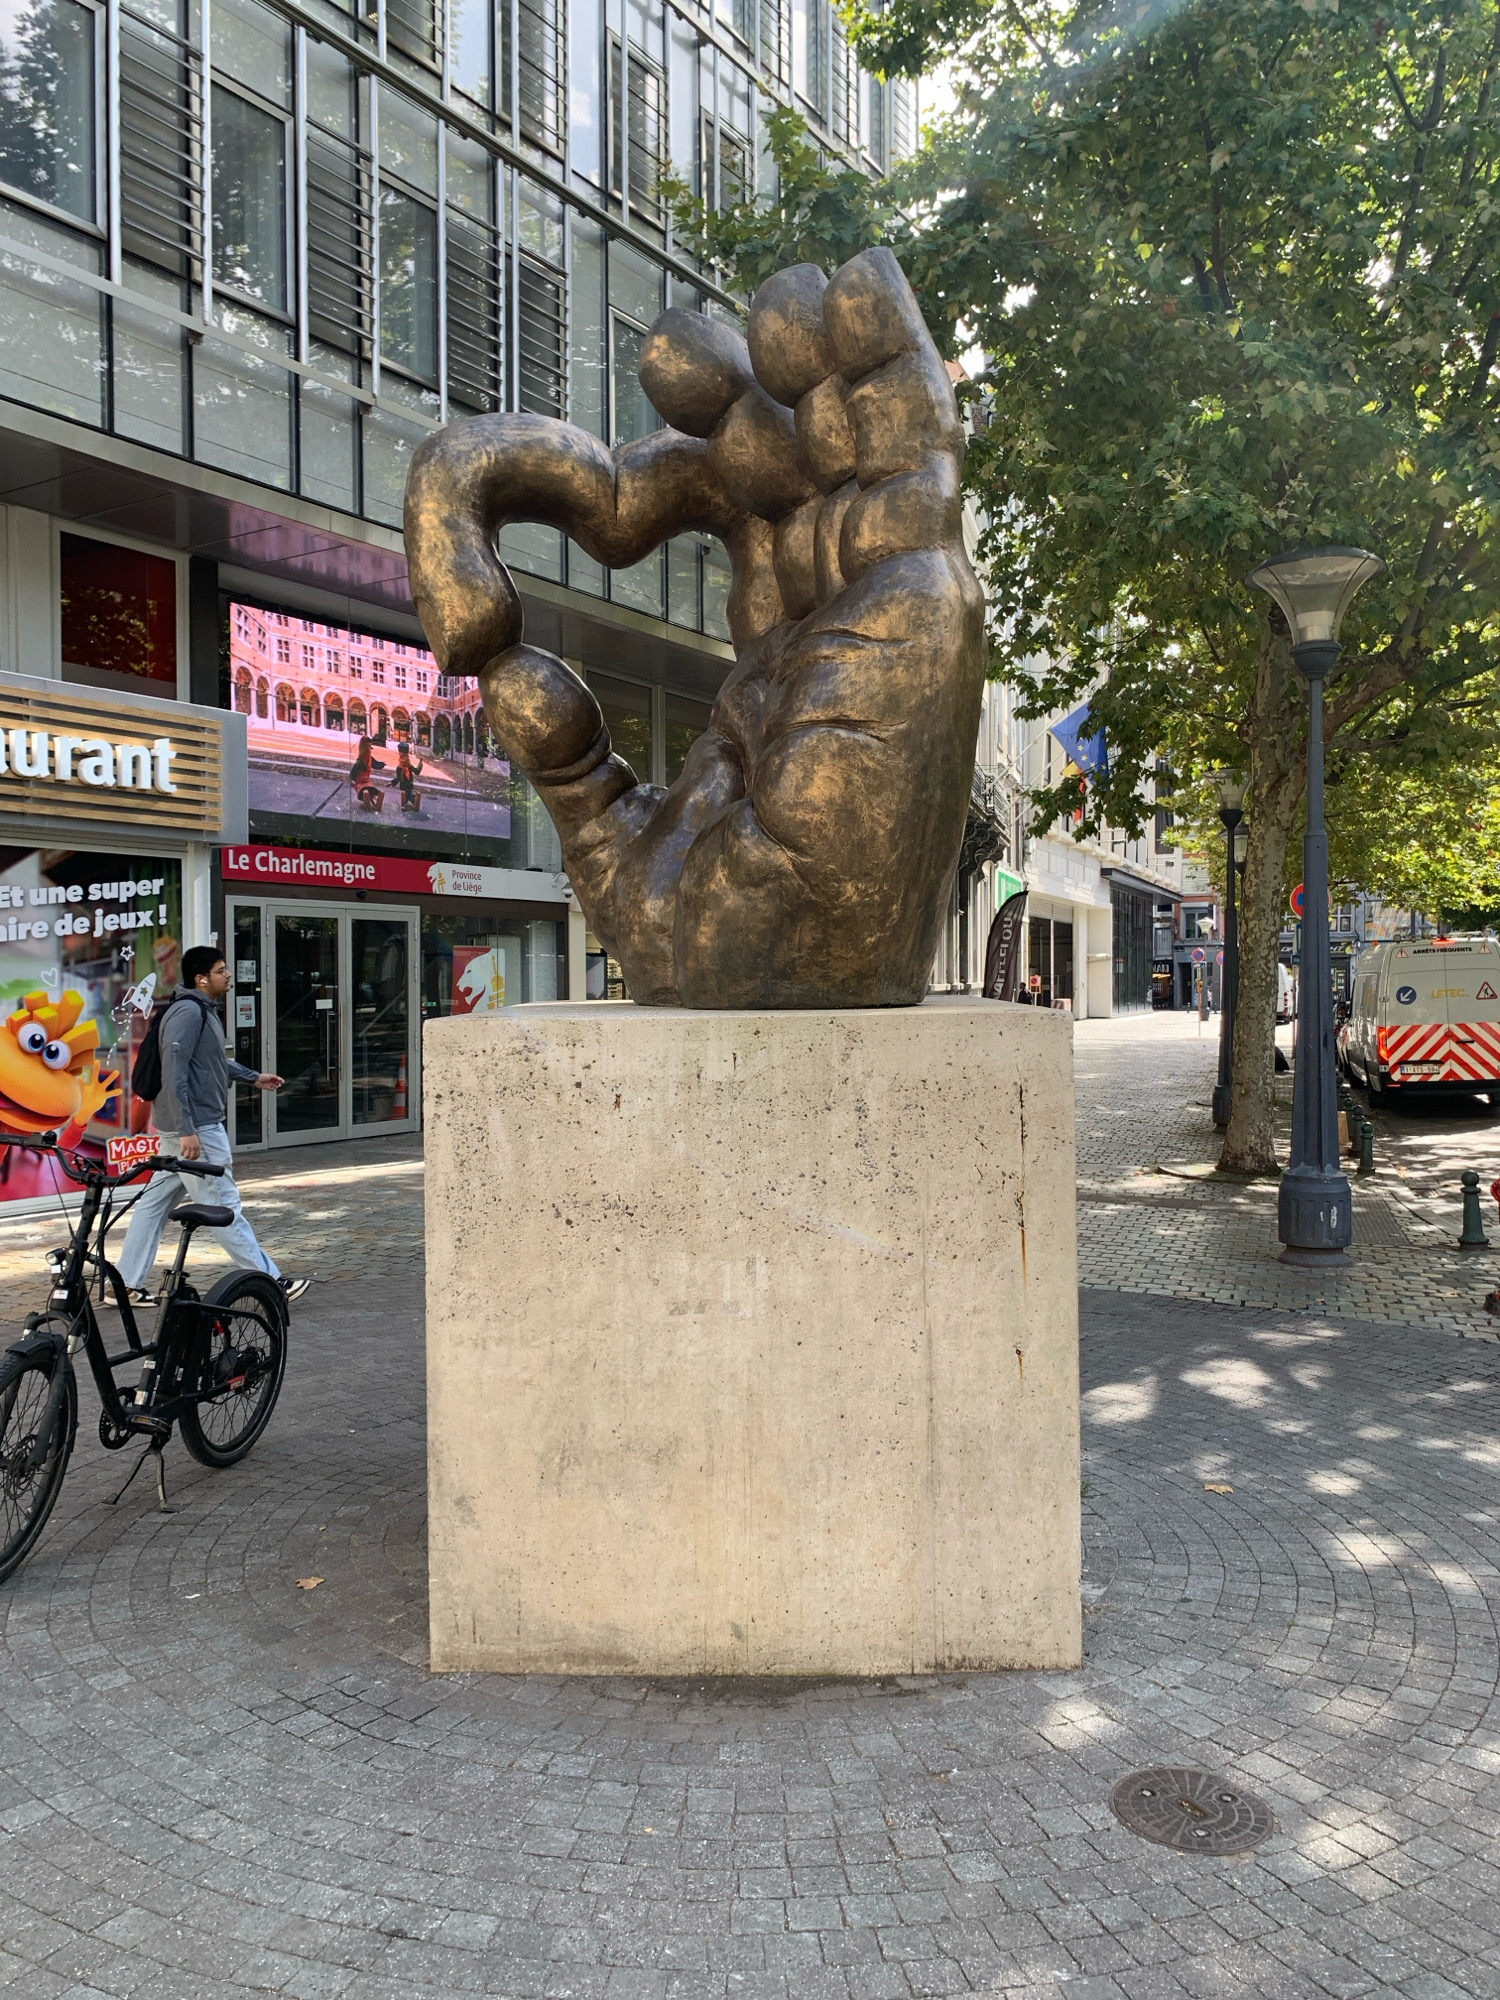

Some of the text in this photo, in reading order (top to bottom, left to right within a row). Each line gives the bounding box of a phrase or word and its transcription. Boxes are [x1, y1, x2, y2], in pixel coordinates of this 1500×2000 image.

[0, 728, 178, 794] urant
[228, 849, 376, 884] Le Charlemagne
[452, 870, 482, 881] Province
[0, 878, 164, 908] Et une super
[452, 882, 483, 895] de Liège
[54, 913, 90, 936] de
[93, 909, 154, 938] jeux
[120, 1156, 150, 1172] PLANE
